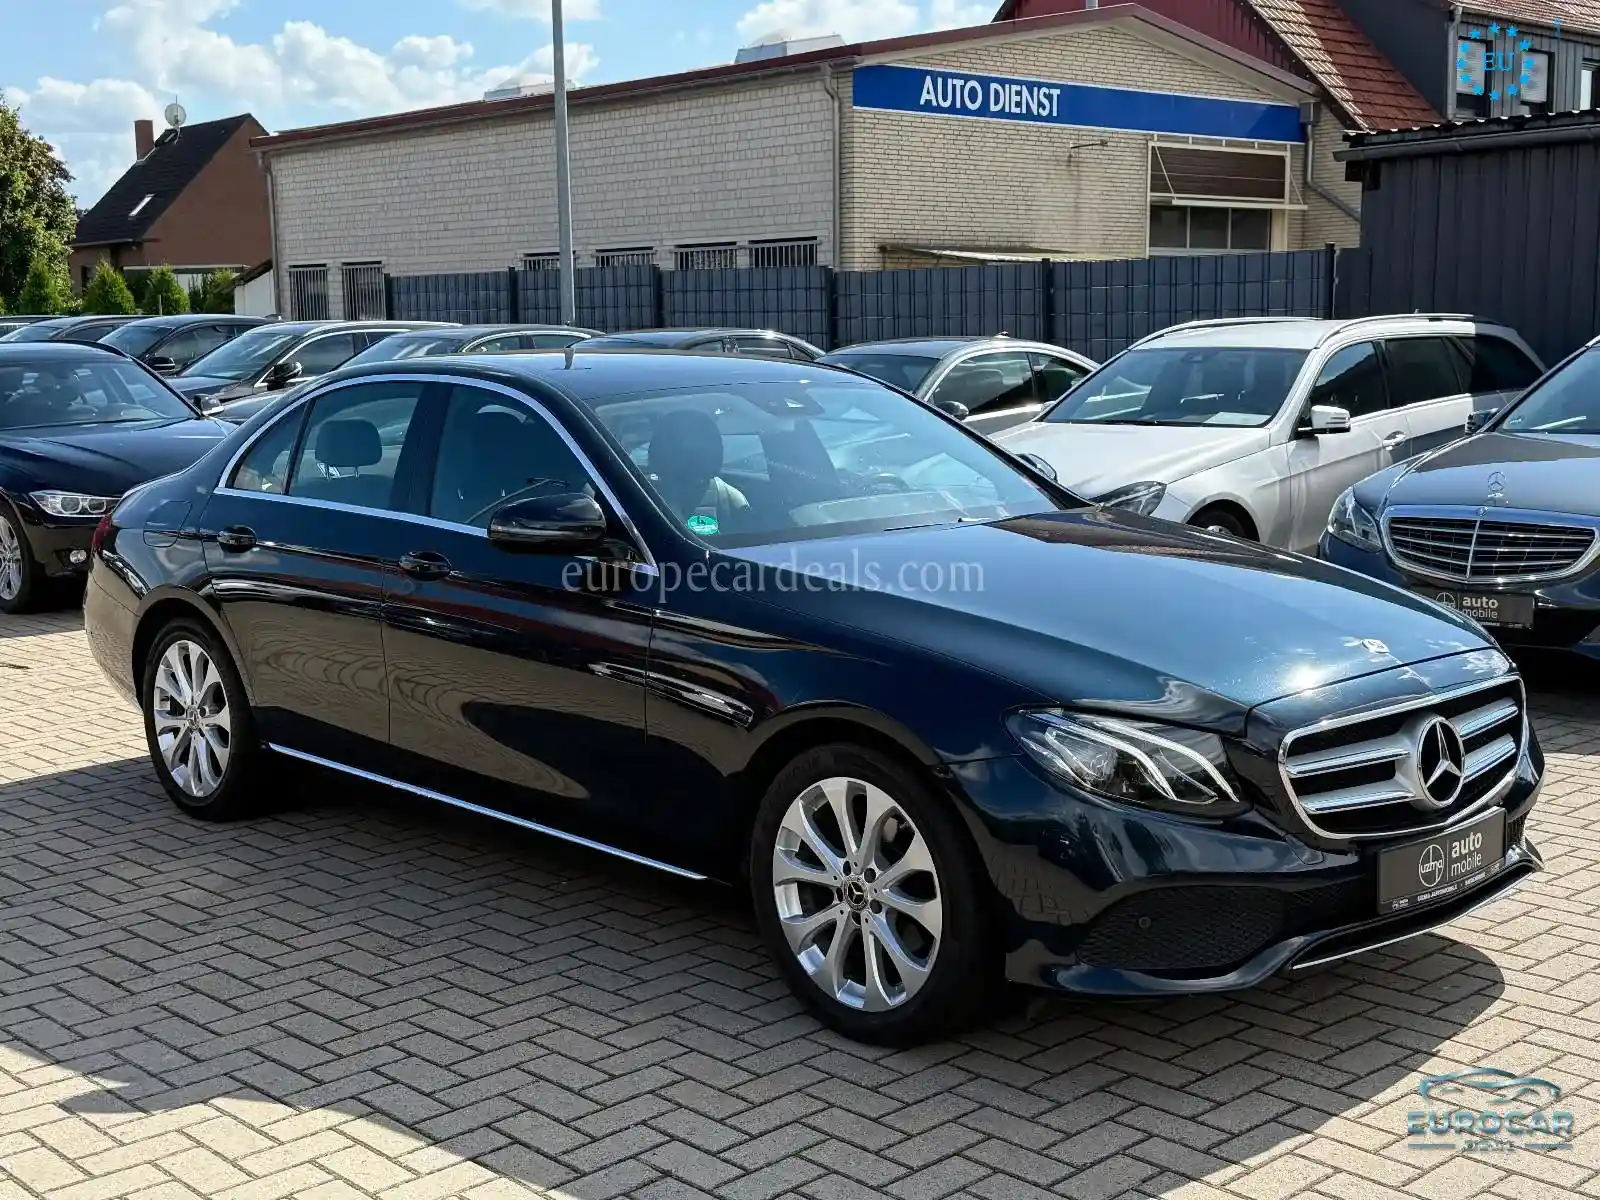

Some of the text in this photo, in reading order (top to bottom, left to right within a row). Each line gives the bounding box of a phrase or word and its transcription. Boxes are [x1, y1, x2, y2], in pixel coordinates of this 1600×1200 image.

[919, 75, 1061, 117] AUTO DIENST
[1462, 596, 1499, 609] auto
[1462, 608, 1498, 620] mobile
[1451, 831, 1482, 857] auto
[1451, 852, 1482, 877] mobile
